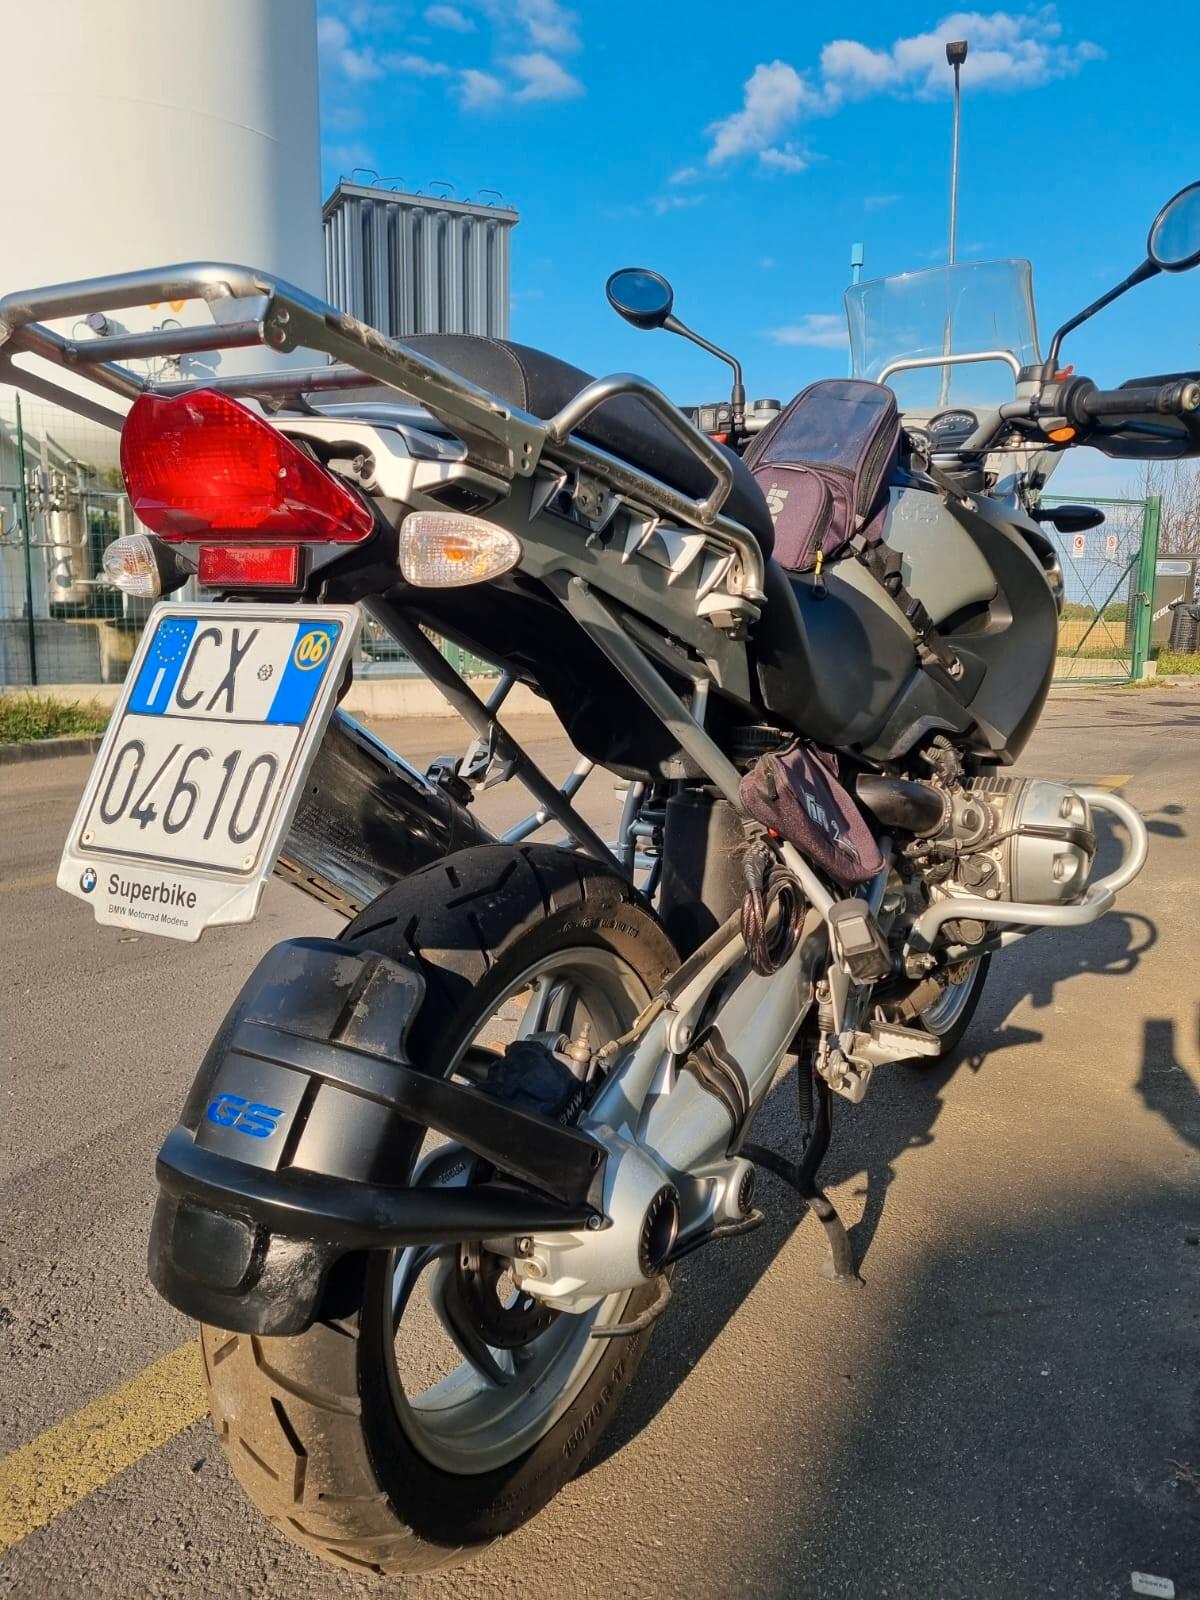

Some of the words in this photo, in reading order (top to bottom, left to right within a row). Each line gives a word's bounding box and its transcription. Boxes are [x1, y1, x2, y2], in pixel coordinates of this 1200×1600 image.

[300, 633, 325, 662] 06
[146, 667, 166, 706] I
[176, 628, 260, 713] CX
[99, 739, 279, 845] 04610
[108, 874, 197, 908] Superbike
[108, 904, 126, 915] BMW
[128, 908, 160, 922] Motorrad
[160, 915, 189, 927] Modena
[207, 1093, 286, 1139] GS
[558, 1089, 584, 1127] BMW
